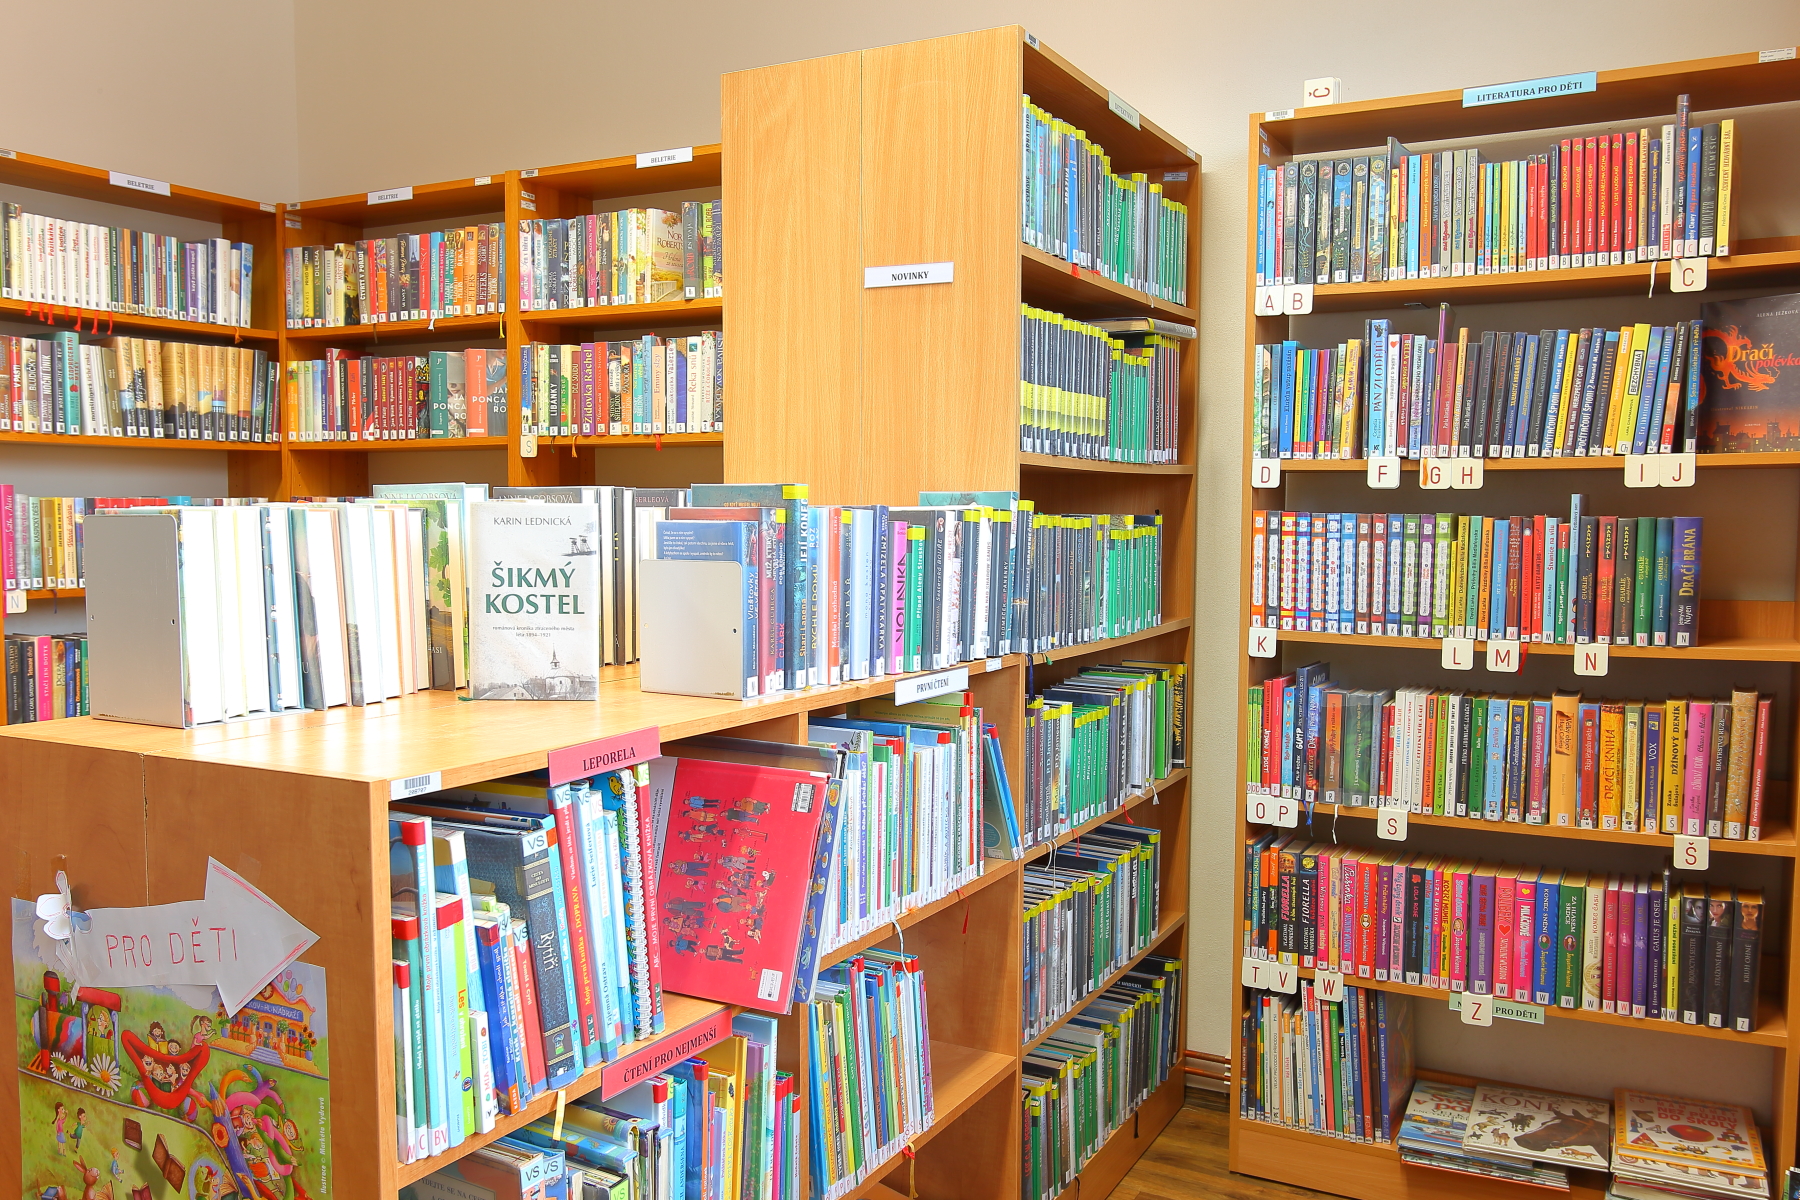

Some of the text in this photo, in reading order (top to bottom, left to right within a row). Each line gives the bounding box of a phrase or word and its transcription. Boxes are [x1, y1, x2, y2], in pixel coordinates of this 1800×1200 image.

[1477, 80, 1583, 103] LITERATURA PRO DĚTI
[651, 154, 676, 163] BELETRIE
[1708, 135, 1717, 177] PŮLMĚSÍC
[127, 179, 155, 191] BELETRIE
[378, 192, 399, 201] BELETRIE
[892, 271, 929, 281] NOVINKY
[1682, 267, 1695, 287] C
[1265, 295, 1274, 311] A
[1293, 293, 1303, 310] B
[1728, 343, 1775, 363] Dračí
[13, 364, 21, 382] PASTI
[28, 358, 37, 391] BLUDIČKY
[40, 355, 52, 395] NOČNÍ ÚNIK
[689, 354, 698, 393] Řeka snů
[1372, 341, 1387, 412] PÁN ZLODĚJŮ
[1630, 353, 1642, 393] BEZCHYBNÁ
[582, 349, 593, 424] Židovka Ráchel
[1550, 392, 1560, 413] ŠPIONI
[1557, 360, 1563, 368] M.
[88, 383, 97, 422] mornštajnová
[549, 383, 558, 416] LÍBÁNKY
[1583, 391, 1594, 412] ŠPIONI
[525, 440, 534, 454] S
[1261, 466, 1272, 483] D
[1378, 465, 1388, 483] F
[1430, 466, 1441, 485] G
[1461, 467, 1473, 486] H
[1671, 463, 1682, 482] J
[527, 492, 574, 503] JACOBSOVÁ
[494, 516, 572, 526] KARIN LEDNICKÁ
[1547, 547, 1555, 571] Štvanice
[1678, 528, 1697, 596] DRAČÍ BRÁNA
[492, 561, 576, 588] ŠIKMÝ
[810, 565, 819, 601] DOMŮ
[10, 595, 20, 609] N
[486, 594, 585, 615] KOSTEL
[747, 572, 755, 620] Vlaštovky
[1682, 605, 1692, 625] Nuyen
[1257, 636, 1267, 653] K
[1453, 647, 1463, 665] L
[1495, 649, 1511, 668] M
[1585, 652, 1597, 671] N
[916, 676, 949, 694] PRVNÍ ČTENÍ
[1296, 728, 1304, 750] GUMP
[1671, 706, 1681, 775] DŽÍNOVÝ DENÍK
[1715, 719, 1725, 771] BRATRSTVO RŮŽE
[583, 747, 636, 771] LEPORELA
[1649, 742, 1657, 761] VOX
[1603, 729, 1615, 800] DRAČÍ KNIHA
[1279, 805, 1289, 822] P
[1387, 818, 1398, 836] S
[1685, 842, 1698, 866] Š
[1344, 867, 1355, 905] Pusinka
[1281, 875, 1290, 921] FIORELLA
[1302, 879, 1310, 924] FIORELLA
[1456, 880, 1464, 917] Sama doma
[1498, 887, 1512, 923] POLIBEK
[1571, 896, 1577, 905] ZA
[1653, 899, 1661, 918] OSEL
[1519, 905, 1532, 937] MILÁČKOVÉ
[105, 916, 239, 969] PRO DĚTI
[540, 931, 558, 971] Rytíři
[1251, 966, 1260, 983] T
[1278, 971, 1288, 989] V
[601, 962, 614, 1028] Tajemná Ostrava
[1322, 977, 1336, 997] W
[1471, 1002, 1484, 1021] Z
[1495, 1007, 1538, 1019] PRO DĚTI
[623, 1025, 717, 1083] ČTENÍ PRO NEJMENŠÍ
[1658, 1113, 1738, 1130] DO ŠKOLY
